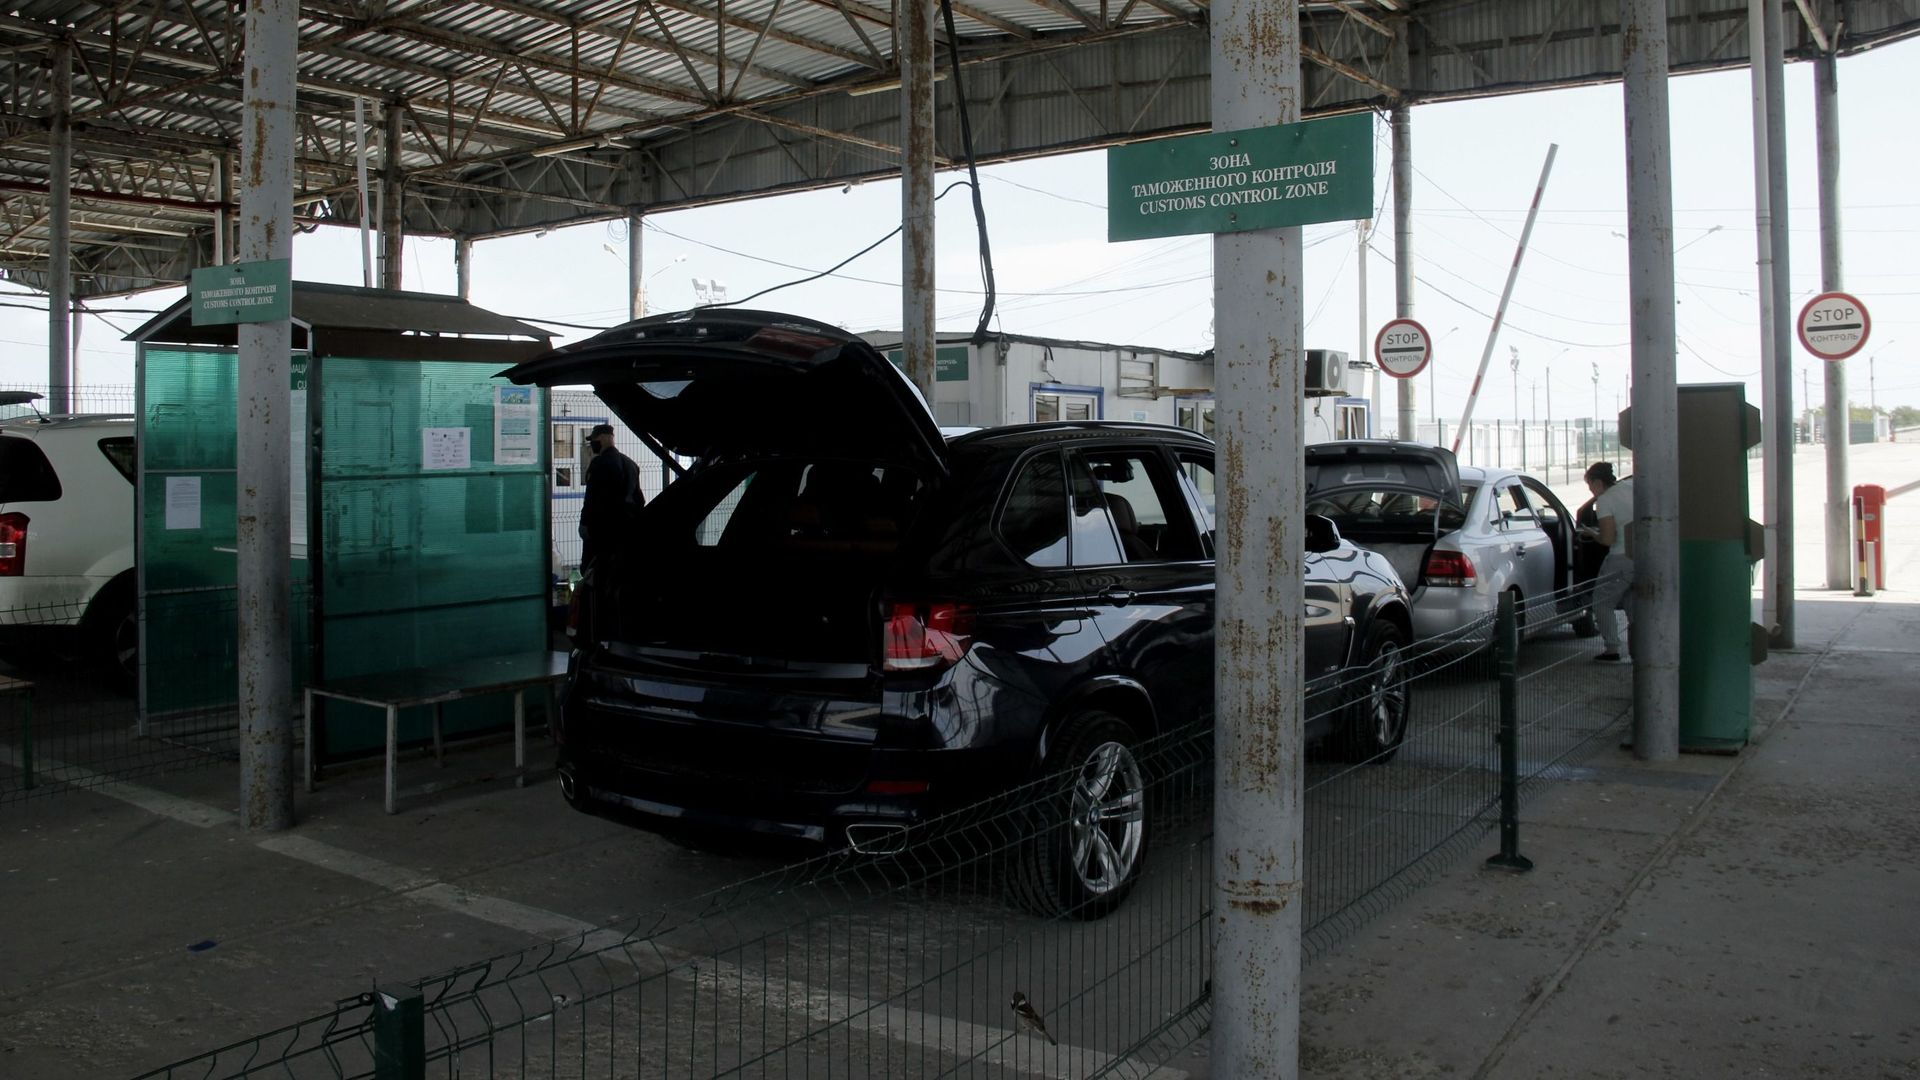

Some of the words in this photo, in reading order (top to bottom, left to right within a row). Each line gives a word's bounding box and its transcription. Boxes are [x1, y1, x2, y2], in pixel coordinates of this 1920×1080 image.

[1209, 153, 1252, 171] ЗОНА
[1132, 171, 1247, 198] ТАМОЖЕННОГО
[1252, 160, 1336, 184] КОНТРОЛЯ
[1140, 195, 1206, 215] CUSTOMS
[1211, 187, 1282, 207] CONTROL
[1285, 181, 1329, 199] ZONE
[204, 299, 228, 308] CUSTOMS
[229, 297, 256, 306] CONTROL
[257, 296, 273, 304] ZONE
[1813, 308, 1854, 322] STOP
[1387, 333, 1418, 344] STOP
[1810, 333, 1858, 342] КОНТРОЛЬ
[1385, 355, 1421, 363] КОНТРОЛЬ
